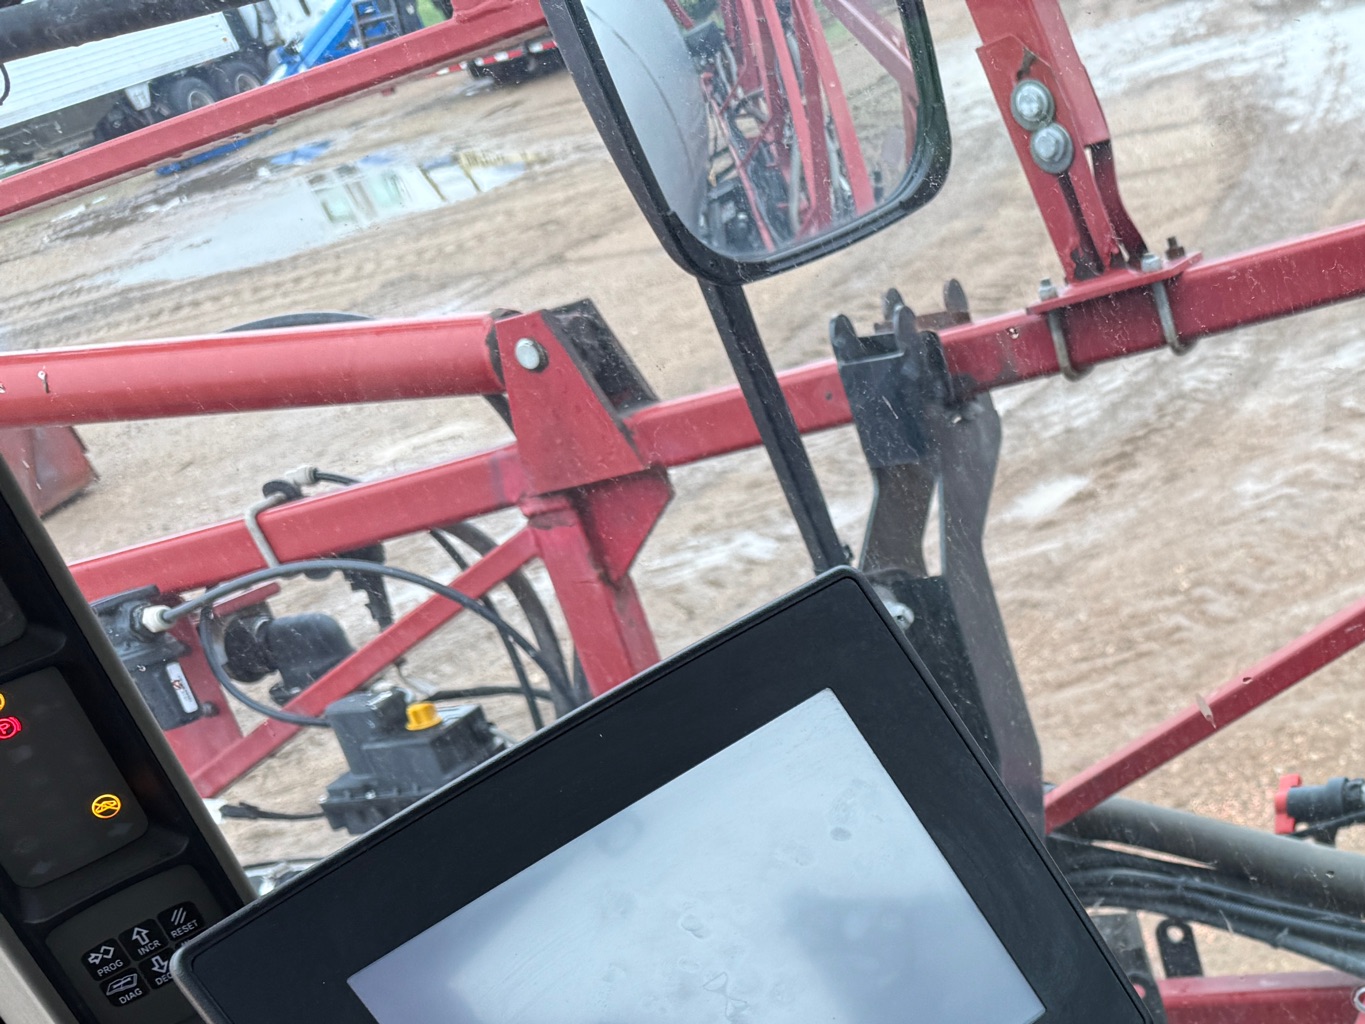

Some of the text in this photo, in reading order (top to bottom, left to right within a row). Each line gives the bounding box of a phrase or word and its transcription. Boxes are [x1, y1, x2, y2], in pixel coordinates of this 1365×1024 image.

[170, 919, 199, 939] RESET
[137, 939, 162, 956] INCR
[96, 959, 124, 977] PROG
[154, 971, 173, 986] DEC
[118, 987, 143, 1004] DIAG
